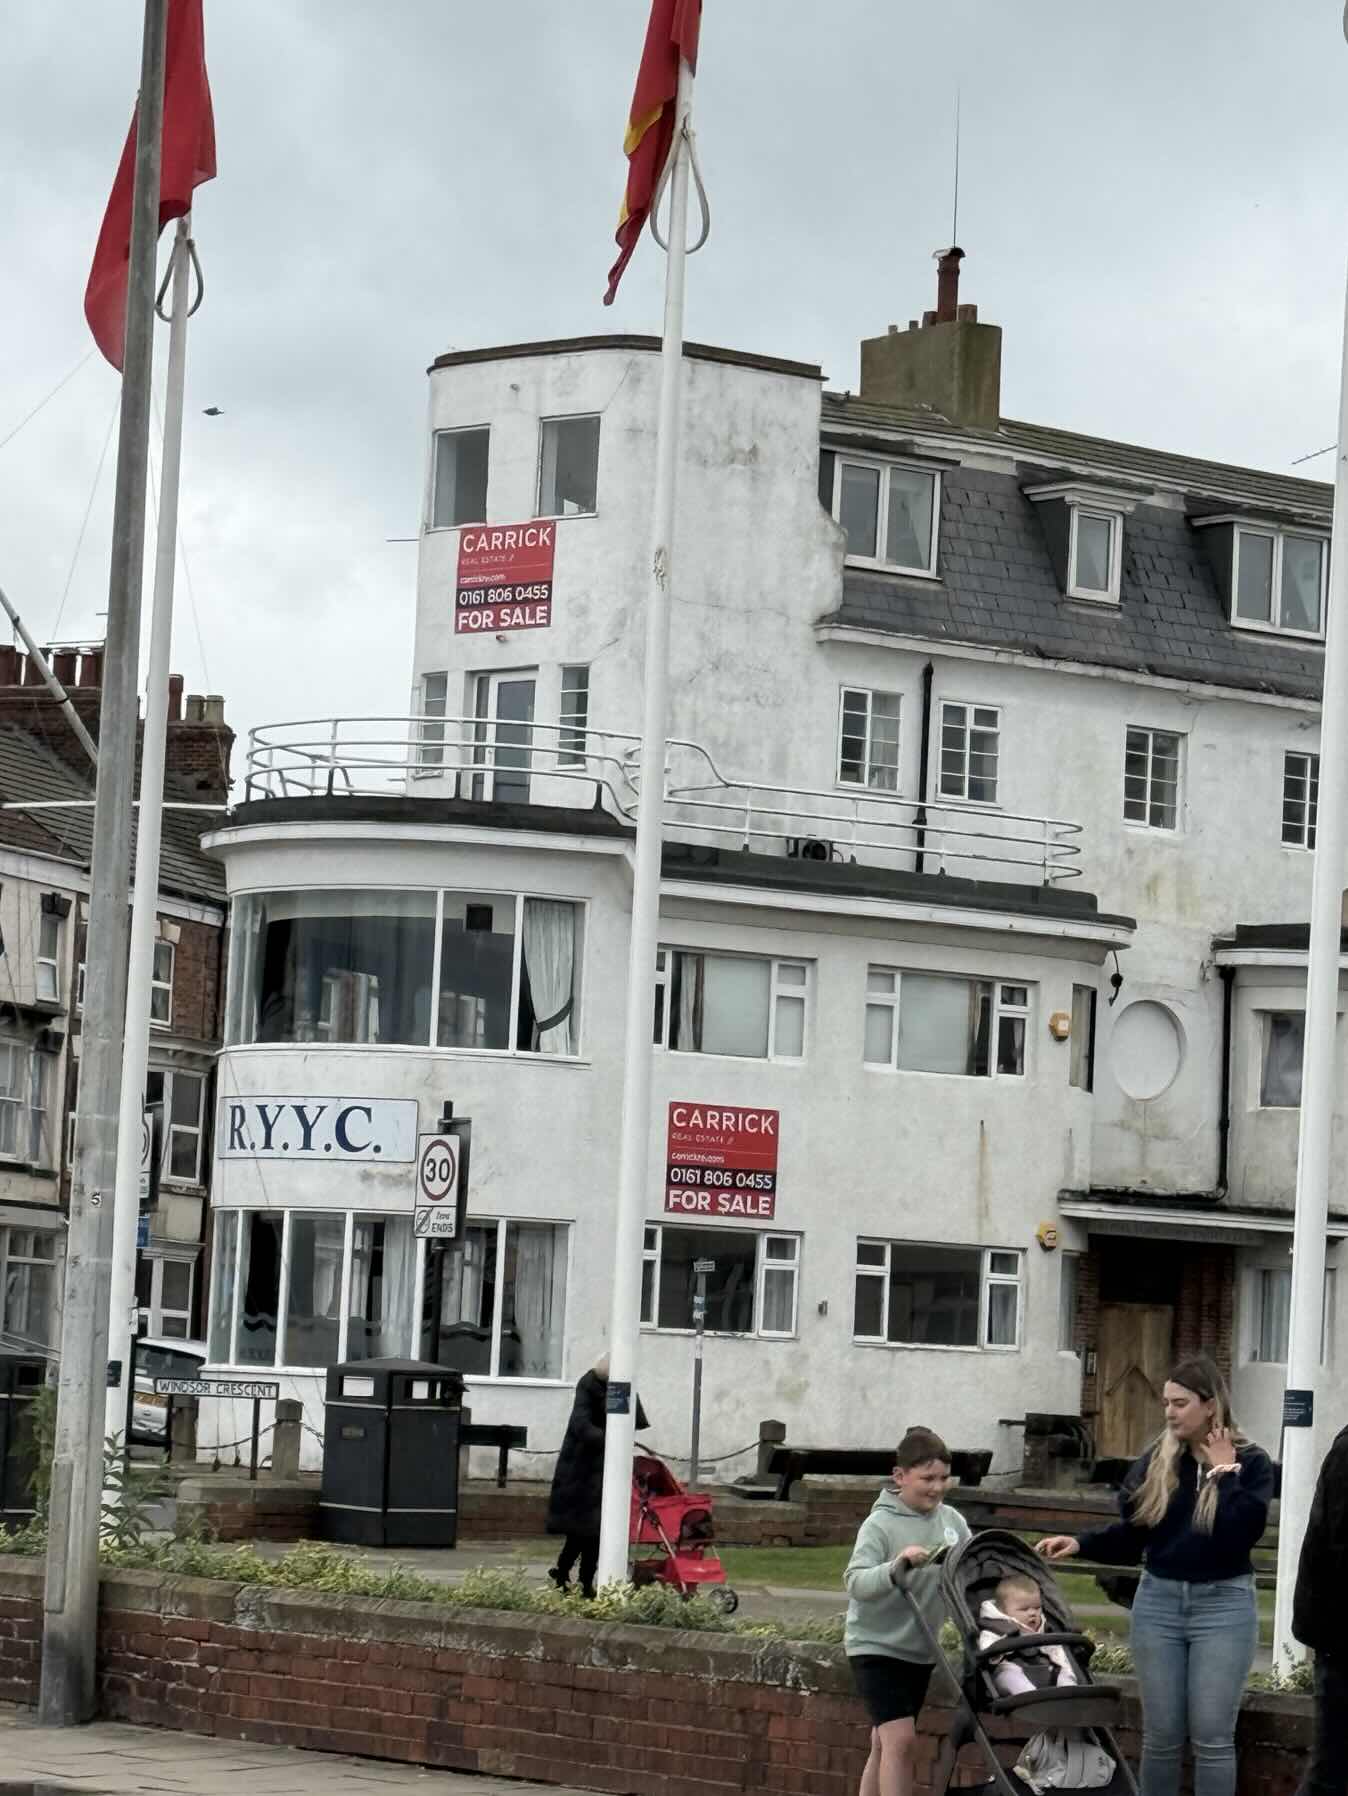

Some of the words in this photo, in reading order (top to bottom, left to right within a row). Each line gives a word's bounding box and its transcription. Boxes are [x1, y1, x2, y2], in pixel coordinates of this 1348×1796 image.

[463, 527, 551, 552] CARRICK
[459, 590, 485, 605] 0161
[487, 588, 512, 603] 806
[515, 584, 548, 601] 0455
[458, 610, 494, 630] FOR
[499, 606, 548, 627] SALE
[228, 1104, 382, 1153] R.Y.Y.C.
[673, 1108, 774, 1135] CARRICK
[425, 1158, 451, 1182] 30
[671, 1168, 701, 1184] 0161
[704, 1170, 732, 1186] 806
[736, 1172, 773, 1189] 0455
[669, 1189, 711, 1211] FOR
[717, 1193, 772, 1215] SALE
[431, 1222, 454, 1233] ENDS
[159, 1380, 211, 1394] WINDSOR
[216, 1383, 273, 1397] CRESCENT
